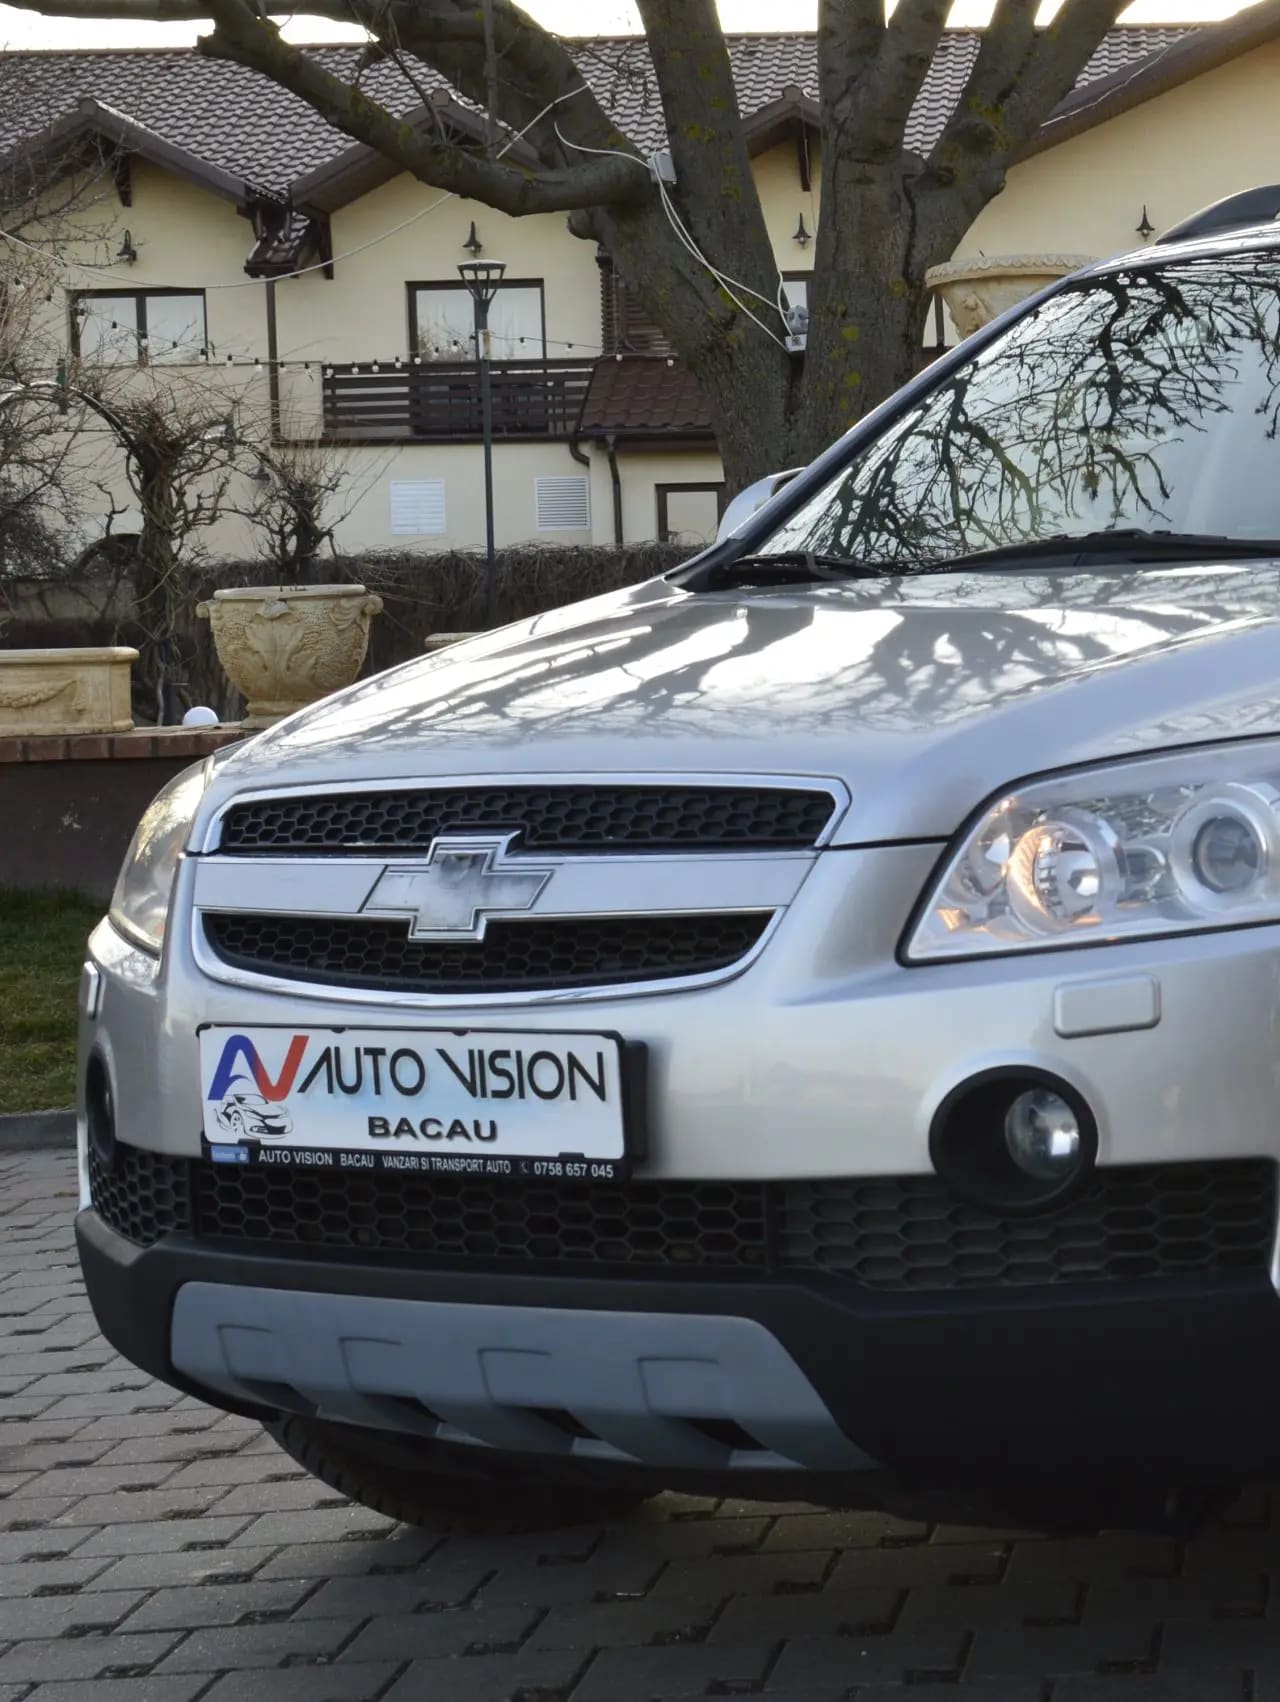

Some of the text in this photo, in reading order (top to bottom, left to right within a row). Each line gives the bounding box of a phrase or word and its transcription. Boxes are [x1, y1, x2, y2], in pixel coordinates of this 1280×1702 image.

[297, 1046, 606, 1102] AUTO VISION
[368, 1116, 497, 1142] BACAU
[259, 1149, 614, 1178] AUTO VISION BACAU VANZARI SI TRANSPORT AUTO 0758 657 045
